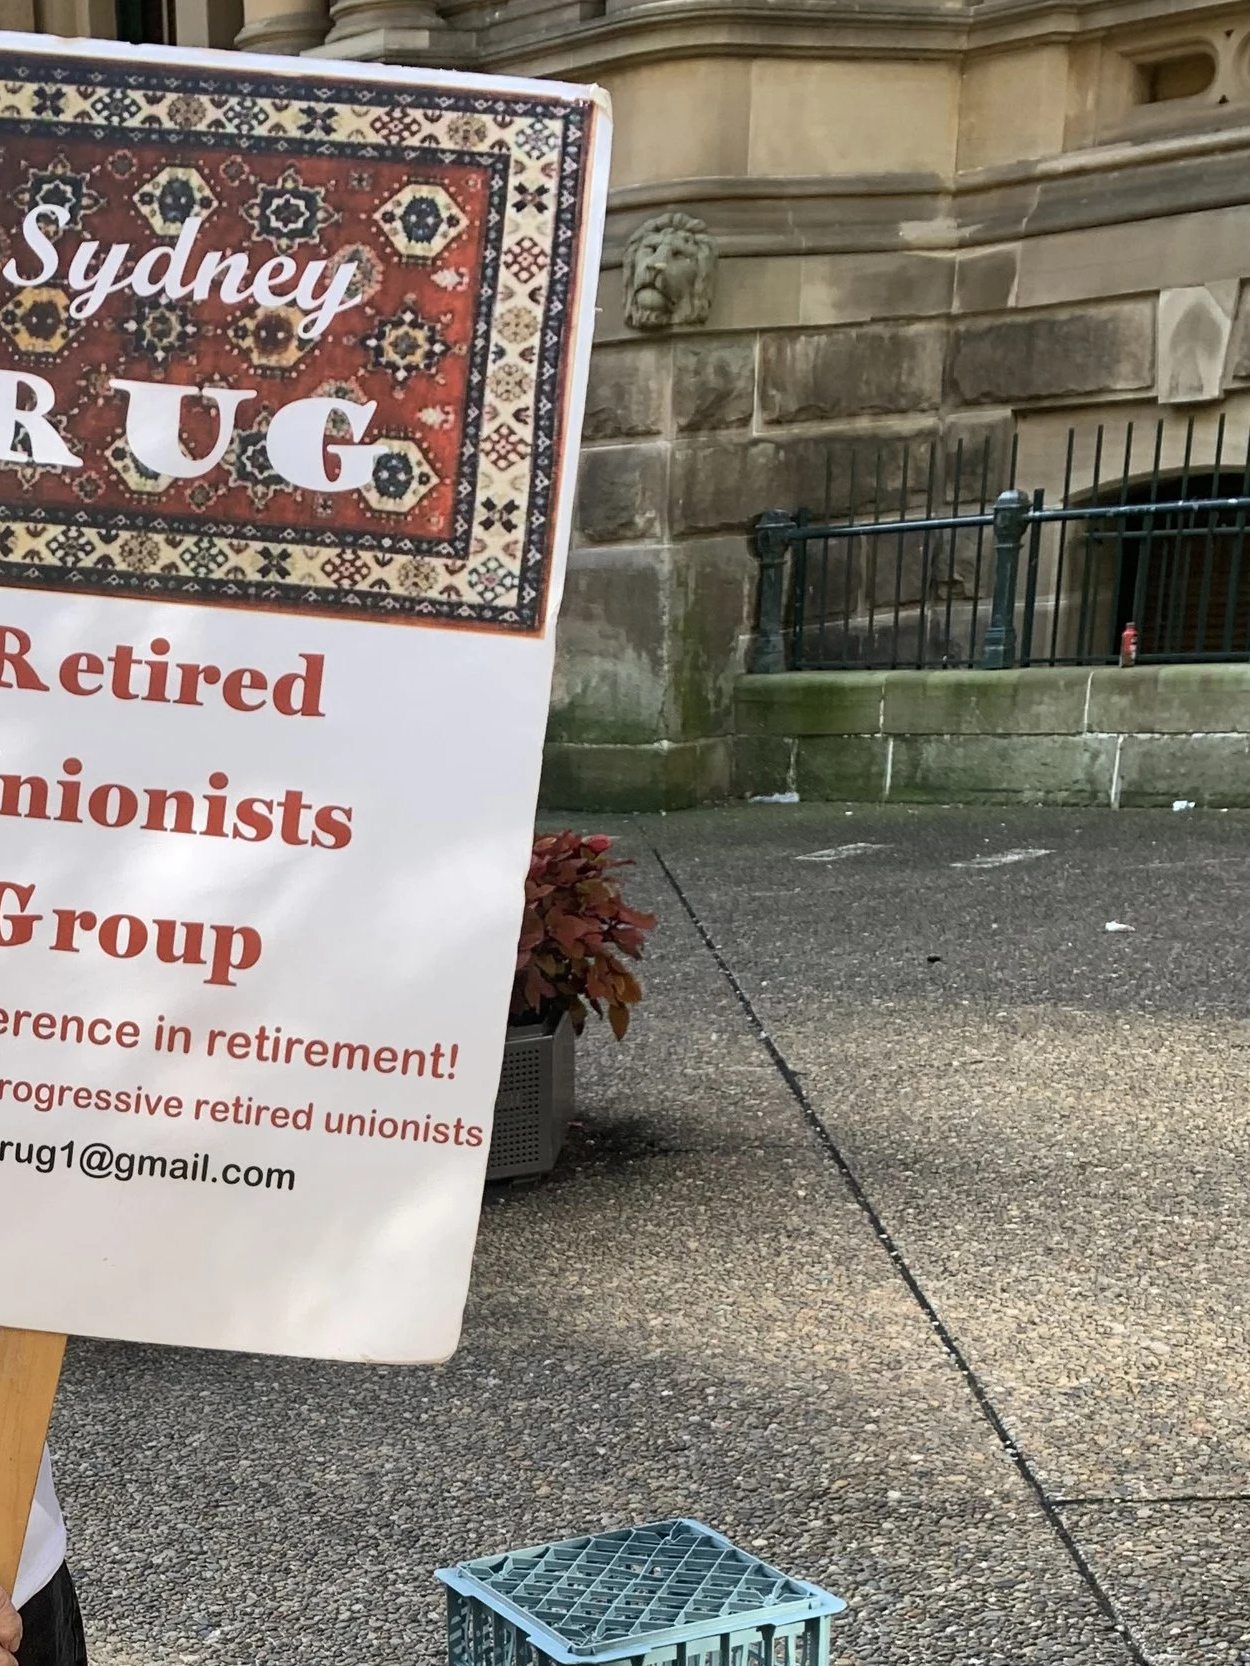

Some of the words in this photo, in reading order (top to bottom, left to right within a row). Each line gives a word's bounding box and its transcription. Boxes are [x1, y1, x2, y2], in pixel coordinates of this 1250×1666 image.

[2, 203, 365, 340] Sydney
[154, 1014, 192, 1054] in
[206, 1025, 460, 1080] retirement!
[193, 1095, 313, 1131] retired
[324, 1108, 483, 1147] unionists
